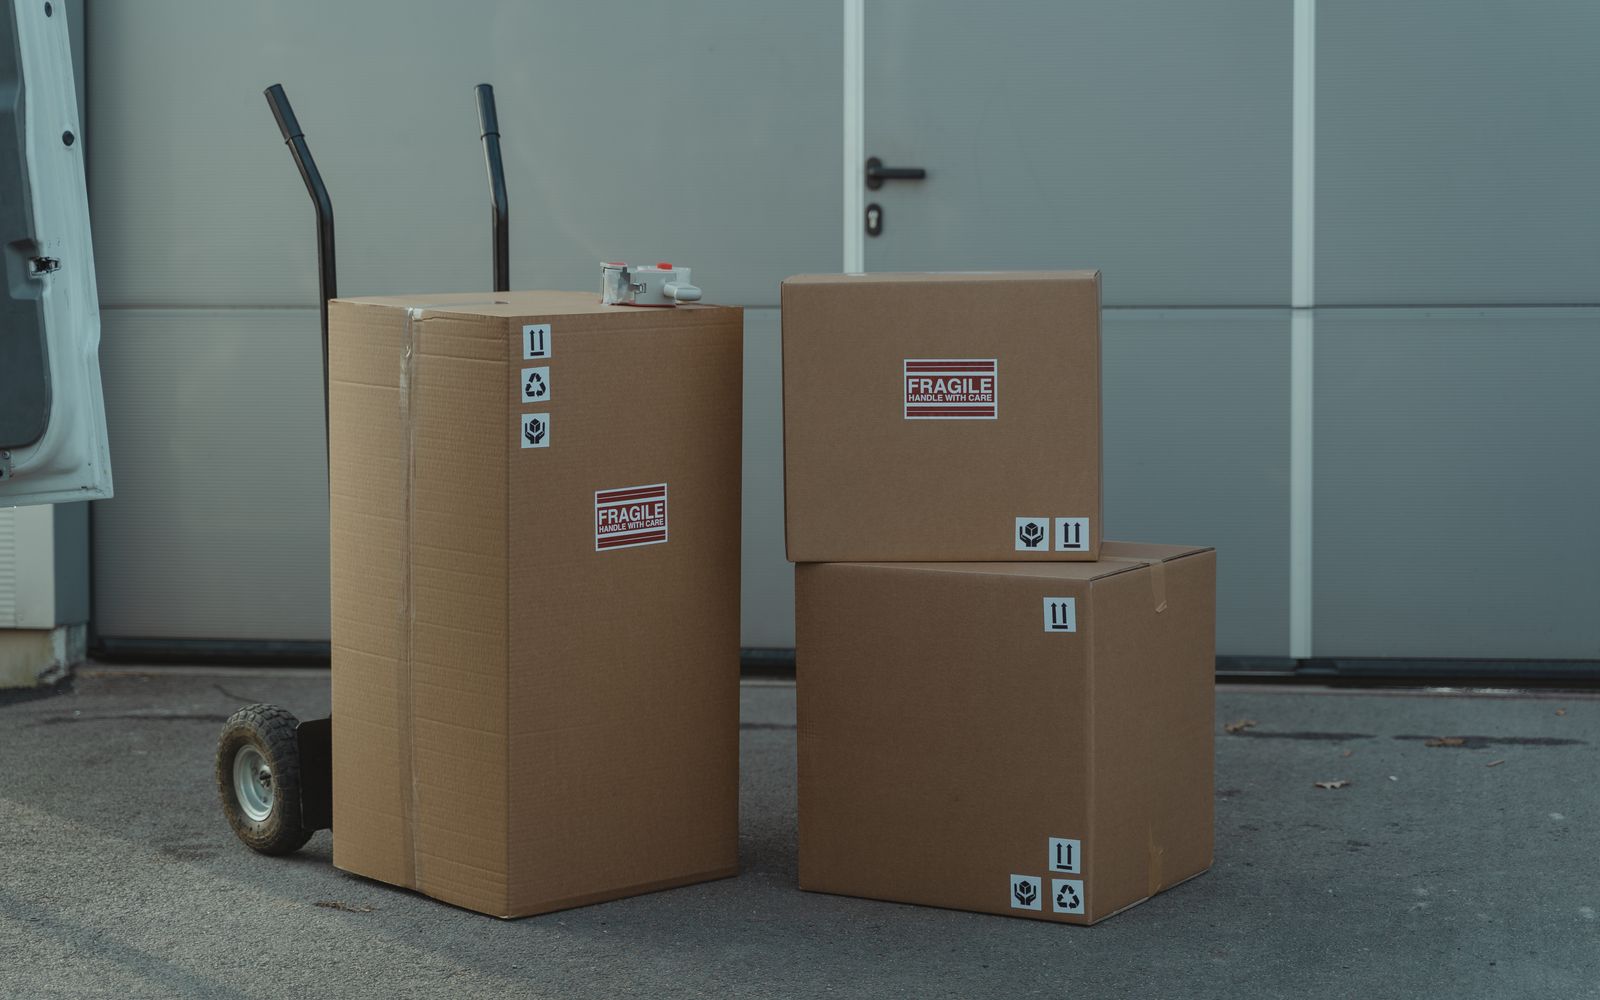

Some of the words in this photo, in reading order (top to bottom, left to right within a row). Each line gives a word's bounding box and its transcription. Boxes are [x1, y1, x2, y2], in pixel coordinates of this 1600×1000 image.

[908, 378, 992, 394] FRAGILE
[908, 394, 943, 402] HANDLE
[945, 394, 966, 402] WITH
[968, 394, 992, 402] CARE
[598, 503, 664, 525] FRAGILE
[599, 522, 627, 533] HANDLE
[627, 521, 644, 530] WITH
[645, 518, 664, 527] CARE
